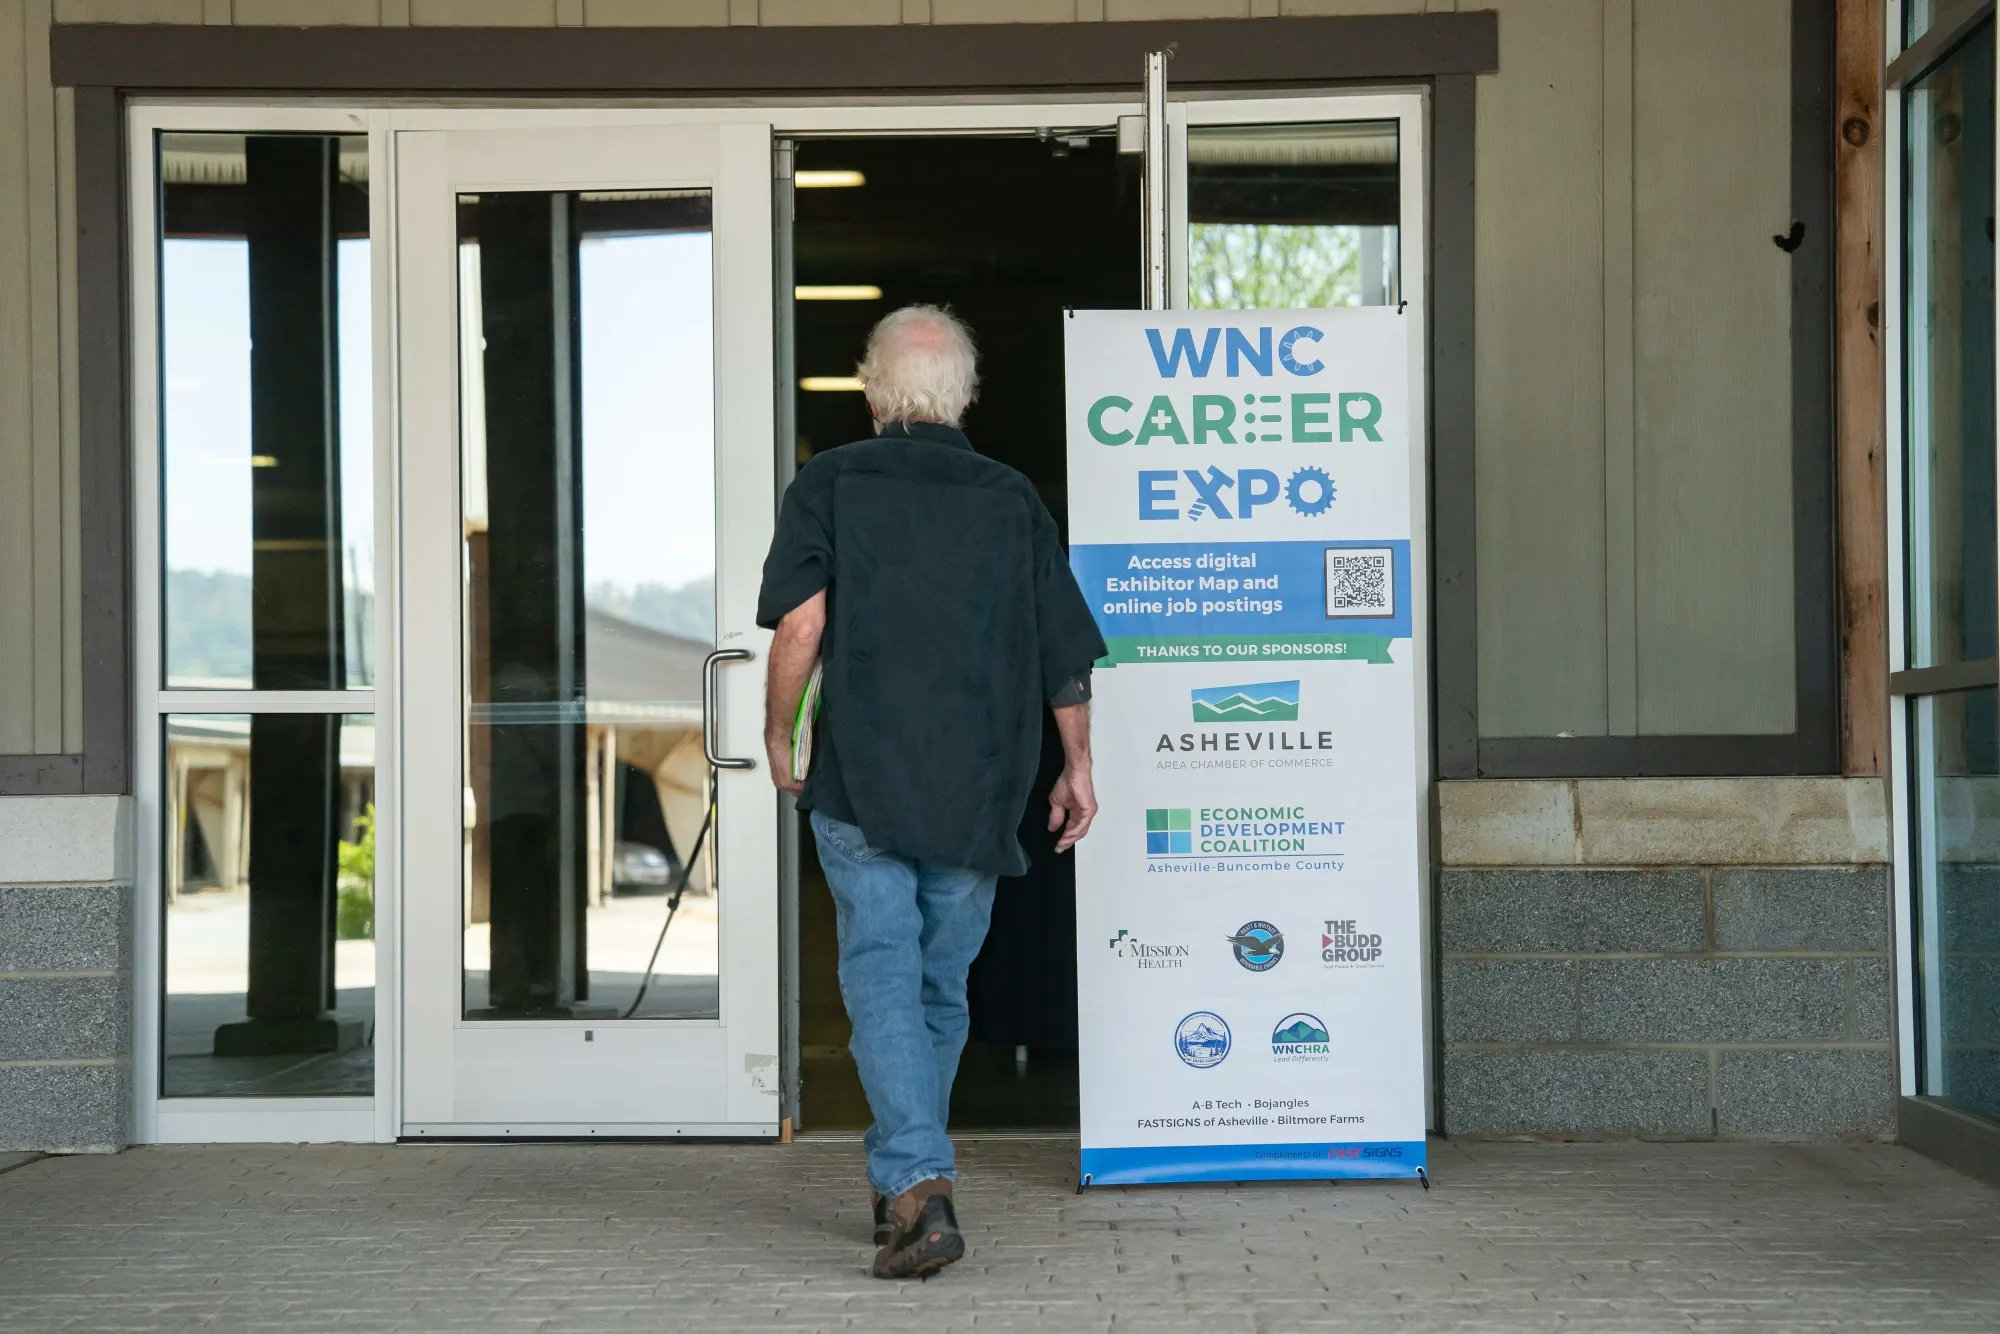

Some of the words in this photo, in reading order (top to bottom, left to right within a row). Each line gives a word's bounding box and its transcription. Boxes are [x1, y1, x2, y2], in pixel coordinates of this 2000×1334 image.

[1144, 326, 1325, 378] WNC
[1087, 392, 1384, 446] CAREER
[1138, 464, 1337, 522] EXPO
[1127, 555, 1192, 570] Access
[1195, 553, 1257, 570] digital
[1106, 576, 1195, 593] Exhibitor
[1199, 576, 1239, 594] Map
[1243, 575, 1279, 590] and
[1103, 599, 1163, 615] online
[1165, 598, 1197, 617] job
[1202, 598, 1283, 617] postings
[1137, 645, 1200, 657] THANKS
[1202, 645, 1223, 656] TO
[1226, 644, 1259, 656] OUR
[1262, 643, 1347, 655] SPONSORS!
[1156, 731, 1333, 752] ASHEVILLE
[1156, 760, 1187, 770] AREA
[1190, 760, 1247, 770] CHAMBER
[1250, 759, 1265, 769] OF
[1267, 758, 1333, 768] COMMERCE
[1200, 807, 1305, 821] ECONOMIC
[1201, 822, 1345, 837] DEVELOPMENT
[1200, 838, 1305, 853] COALITION
[1147, 860, 1291, 874] Asheville-Buncombe
[1295, 860, 1345, 872] County
[1324, 920, 1356, 935] THE
[1335, 934, 1382, 949] BUDD
[1321, 948, 1382, 962] GROUP
[1272, 1044, 1330, 1055] WNCHRA
[1273, 1055, 1291, 1063] Lead
[1292, 1055, 1330, 1063] Differently
[1192, 1100, 1213, 1110] A-B
[1215, 1099, 1242, 1109] Tech
[1254, 1098, 1310, 1110] Bojangles
[1137, 1117, 1200, 1128] FASTSIGNS
[1203, 1116, 1215, 1127] of
[1217, 1115, 1269, 1126] Asheville
[1277, 1114, 1327, 1125] Biltmore
[1330, 1114, 1365, 1124] Farms
[1255, 1151, 1311, 1160] Compliments
[1312, 1149, 1322, 1158] of
[1327, 1147, 1402, 1159] FASTSIGNS
